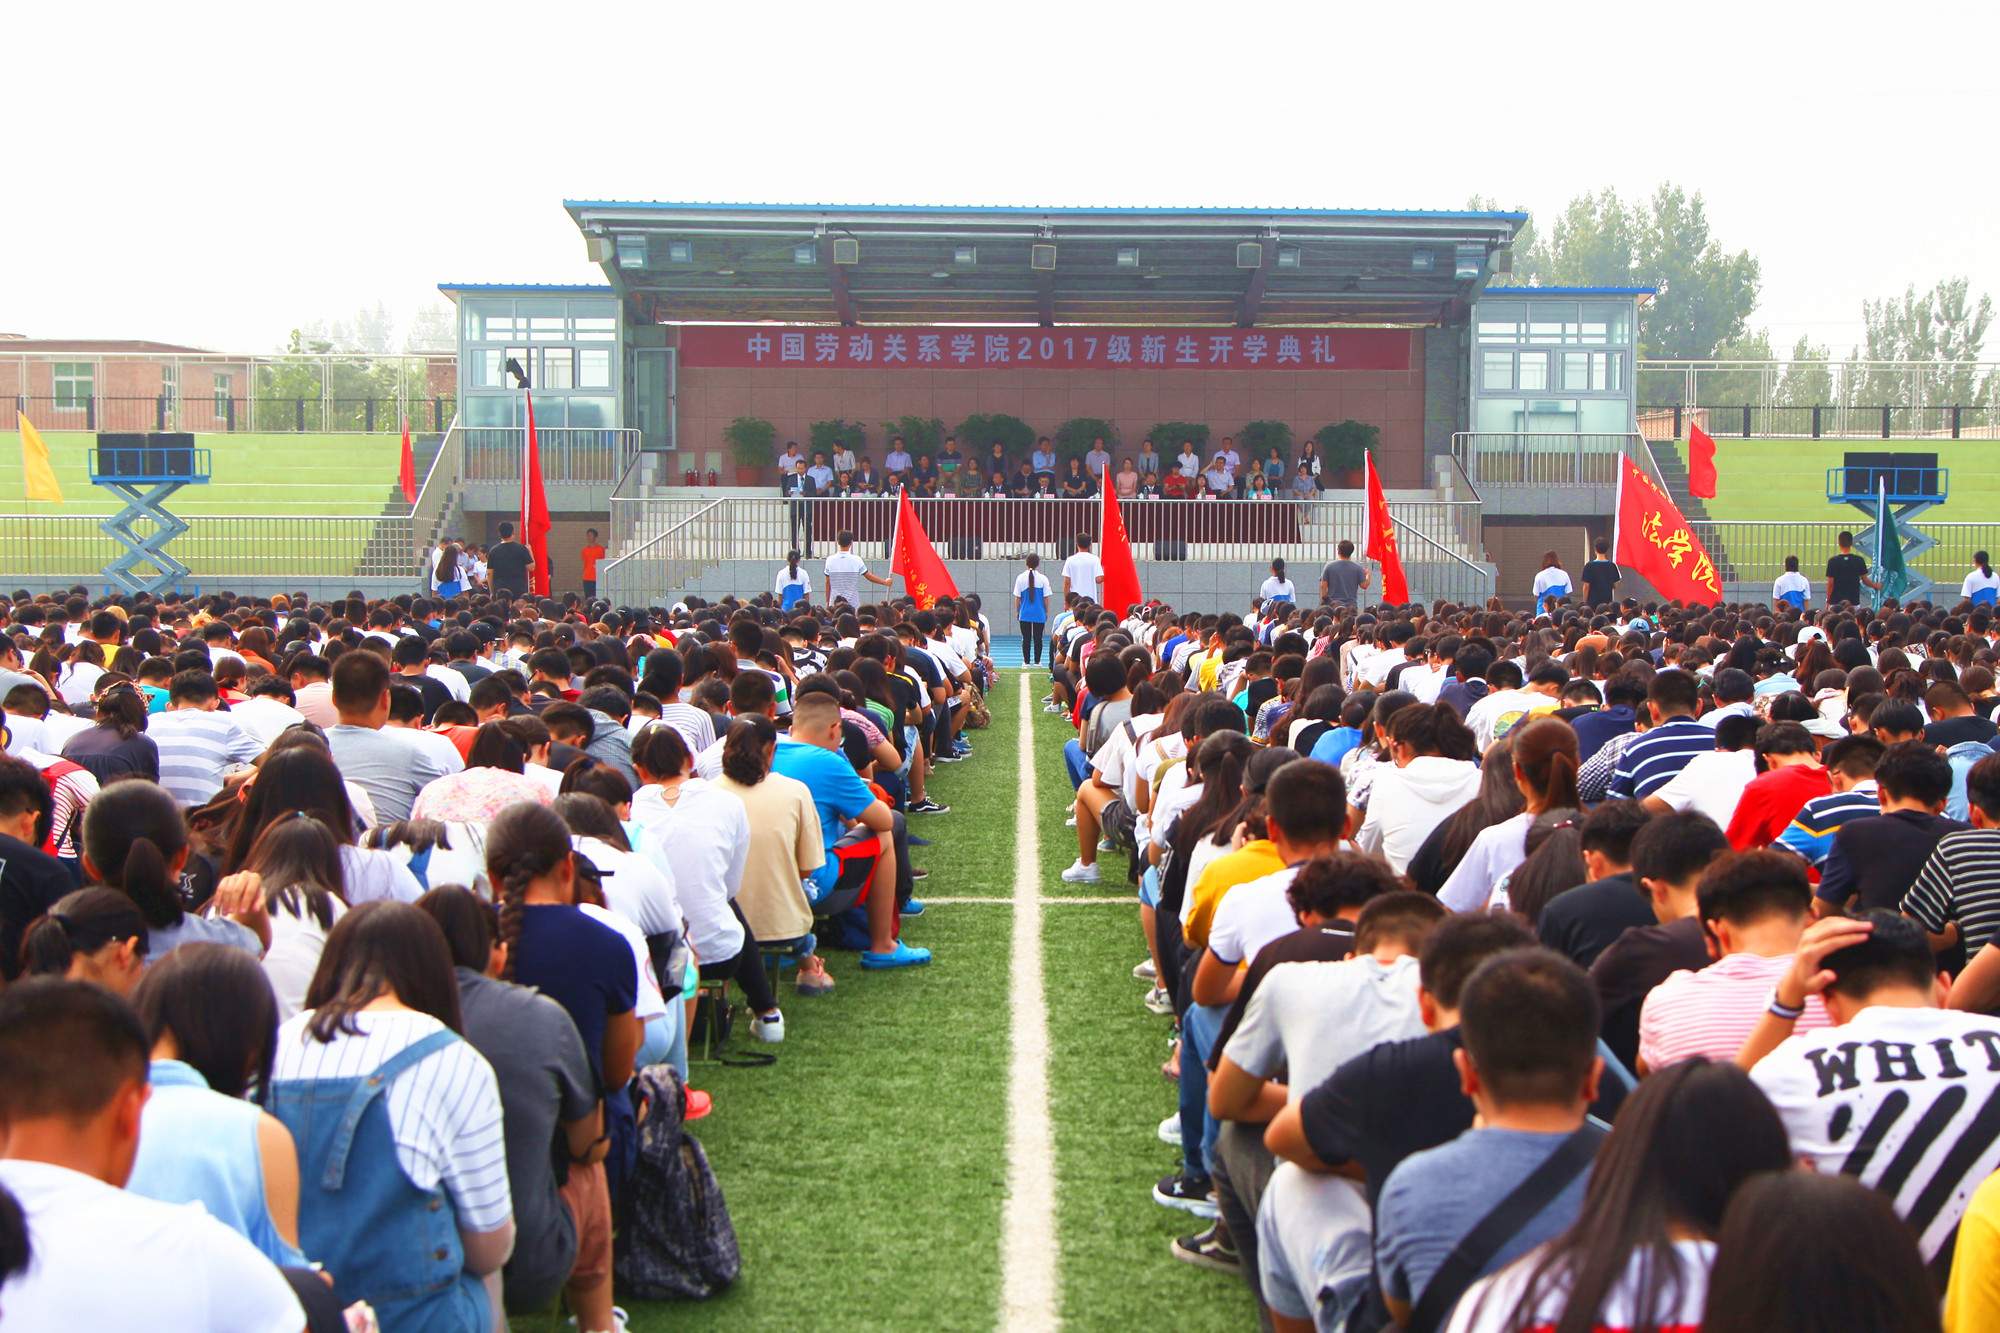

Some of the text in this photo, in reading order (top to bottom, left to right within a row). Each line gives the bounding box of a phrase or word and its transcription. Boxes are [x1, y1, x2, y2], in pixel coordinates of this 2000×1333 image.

[747, 332, 1336, 364] 中国劳动关系学院2017级新生开学典礼
[1641, 510, 1719, 595] 法学院
